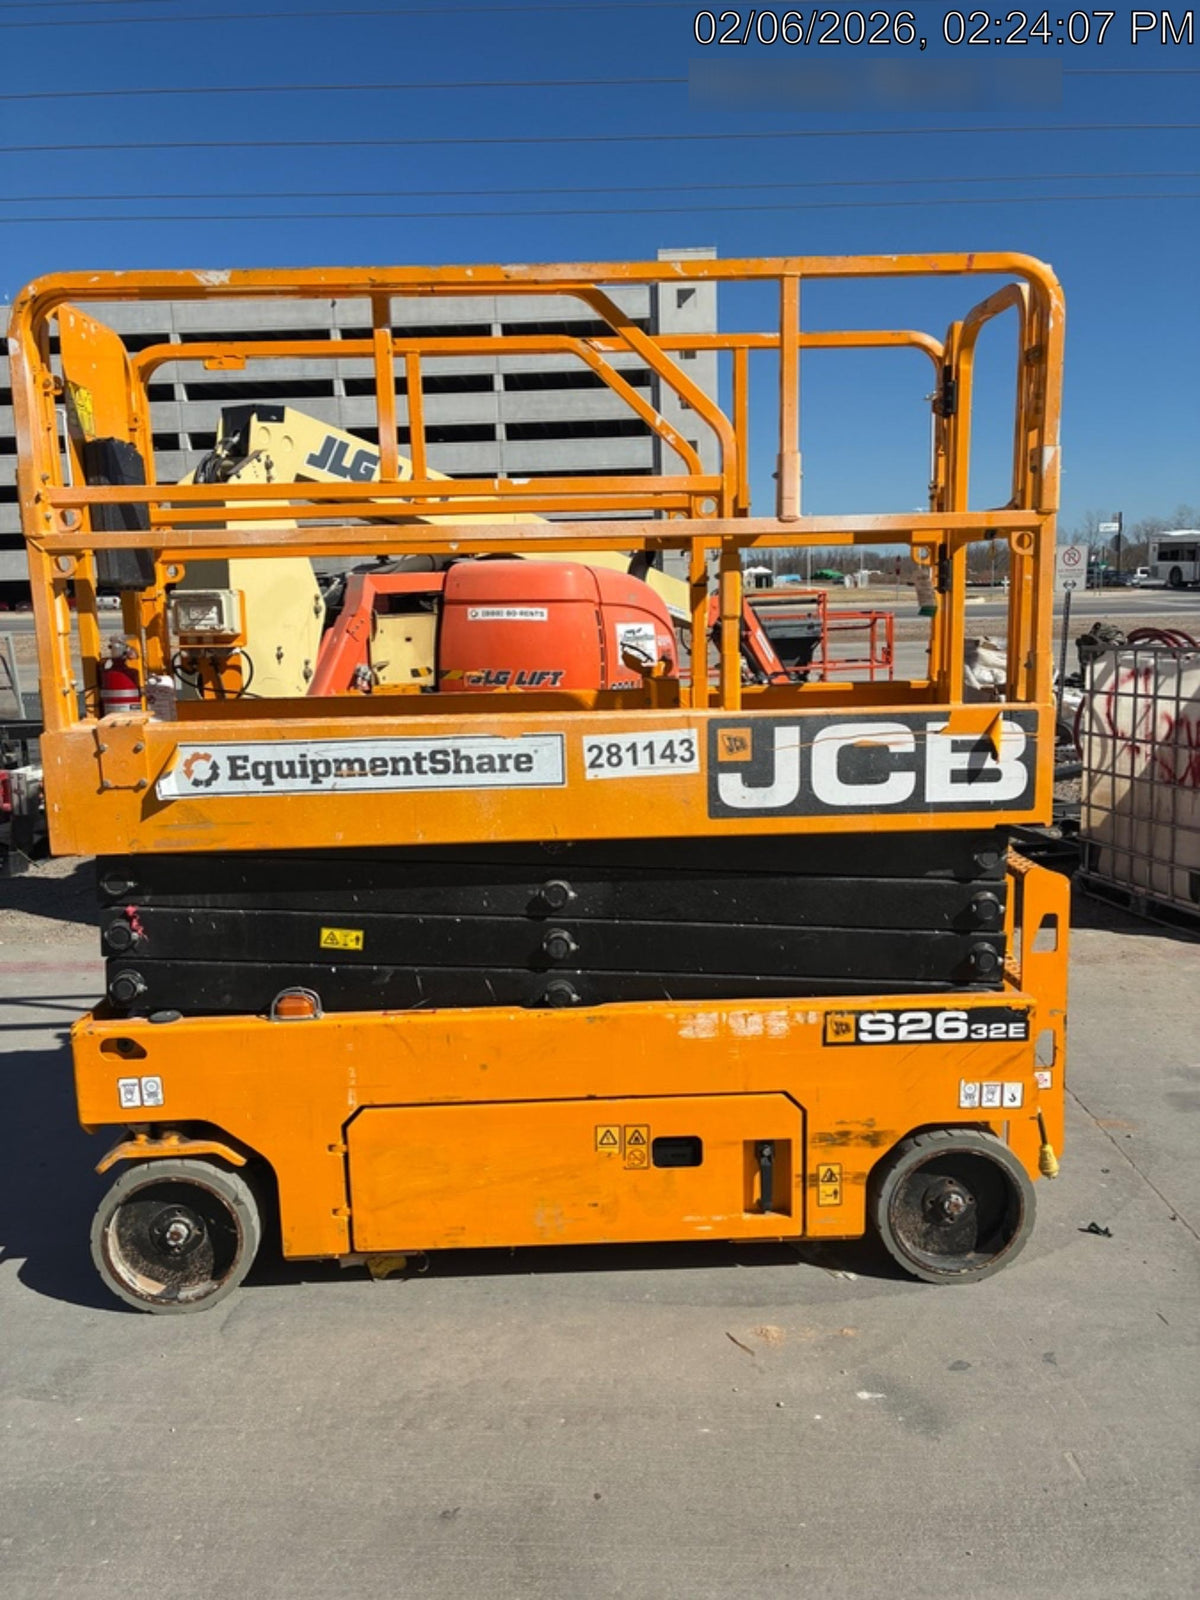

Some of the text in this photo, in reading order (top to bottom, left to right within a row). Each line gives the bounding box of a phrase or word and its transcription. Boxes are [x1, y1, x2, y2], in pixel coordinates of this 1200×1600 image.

[306, 435, 380, 482] JLG
[514, 670, 564, 686] LIFT
[226, 747, 534, 787] EquipmentShare
[586, 738, 696, 770] 281143
[717, 720, 1029, 809] JCB
[858, 1011, 1027, 1043] S26 32E
